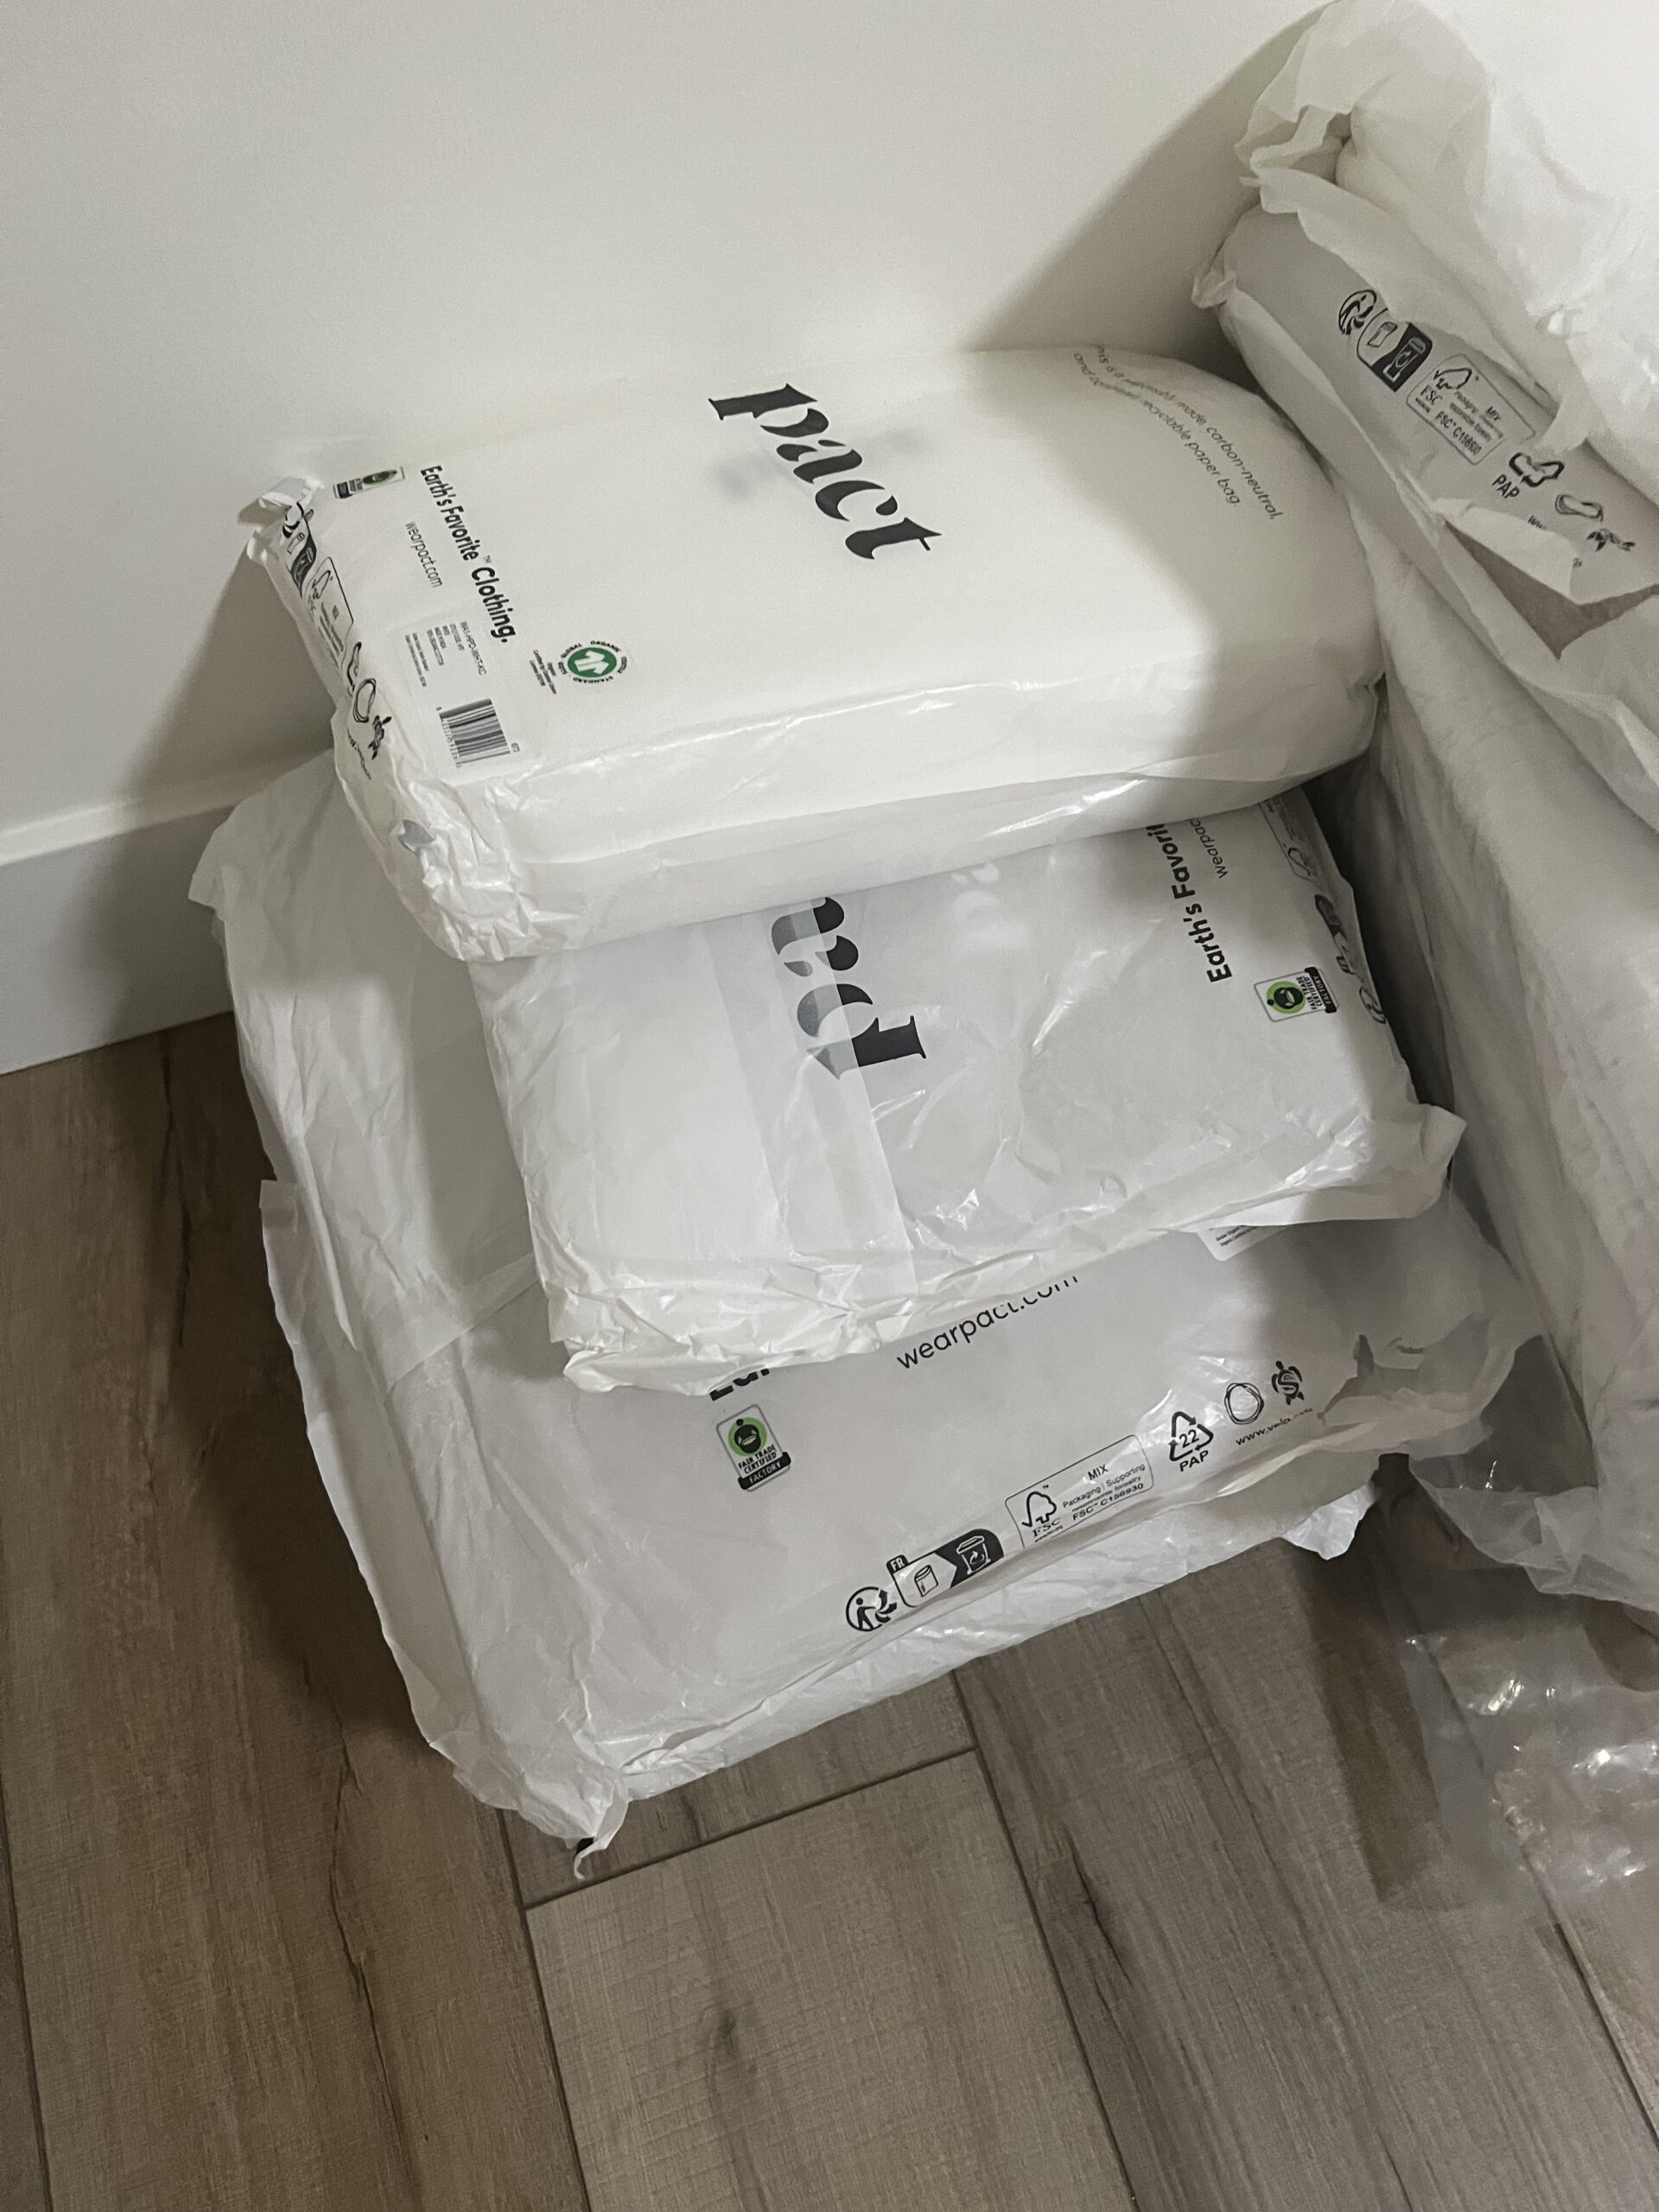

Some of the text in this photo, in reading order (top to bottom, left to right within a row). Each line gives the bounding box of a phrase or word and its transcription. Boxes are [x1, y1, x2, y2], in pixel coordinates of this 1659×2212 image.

[1184, 438, 1221, 476] paper
[708, 383, 943, 560] pact
[1491, 474, 1520, 499] PAP
[405, 521, 442, 588] wearpact.com
[421, 465, 456, 506] Earth's
[440, 505, 480, 562] Favorite
[471, 567, 517, 644] Clothing.
[1190, 818, 1229, 879] wearpac
[1182, 902, 1233, 982] Earth's
[1179, 1428, 1200, 1448] 22
[738, 1444, 776, 1470] FAIR TRADE
[744, 1452, 778, 1474] CERTIFIED
[1179, 1450, 1210, 1472] PAP
[749, 1460, 782, 1484] FACTORY
[1088, 1464, 1109, 1481] MIX
[1063, 1464, 1146, 1508] Packaging Supporting
[1032, 1517, 1061, 1537] FSC
[890, 1558, 905, 1572] FR
